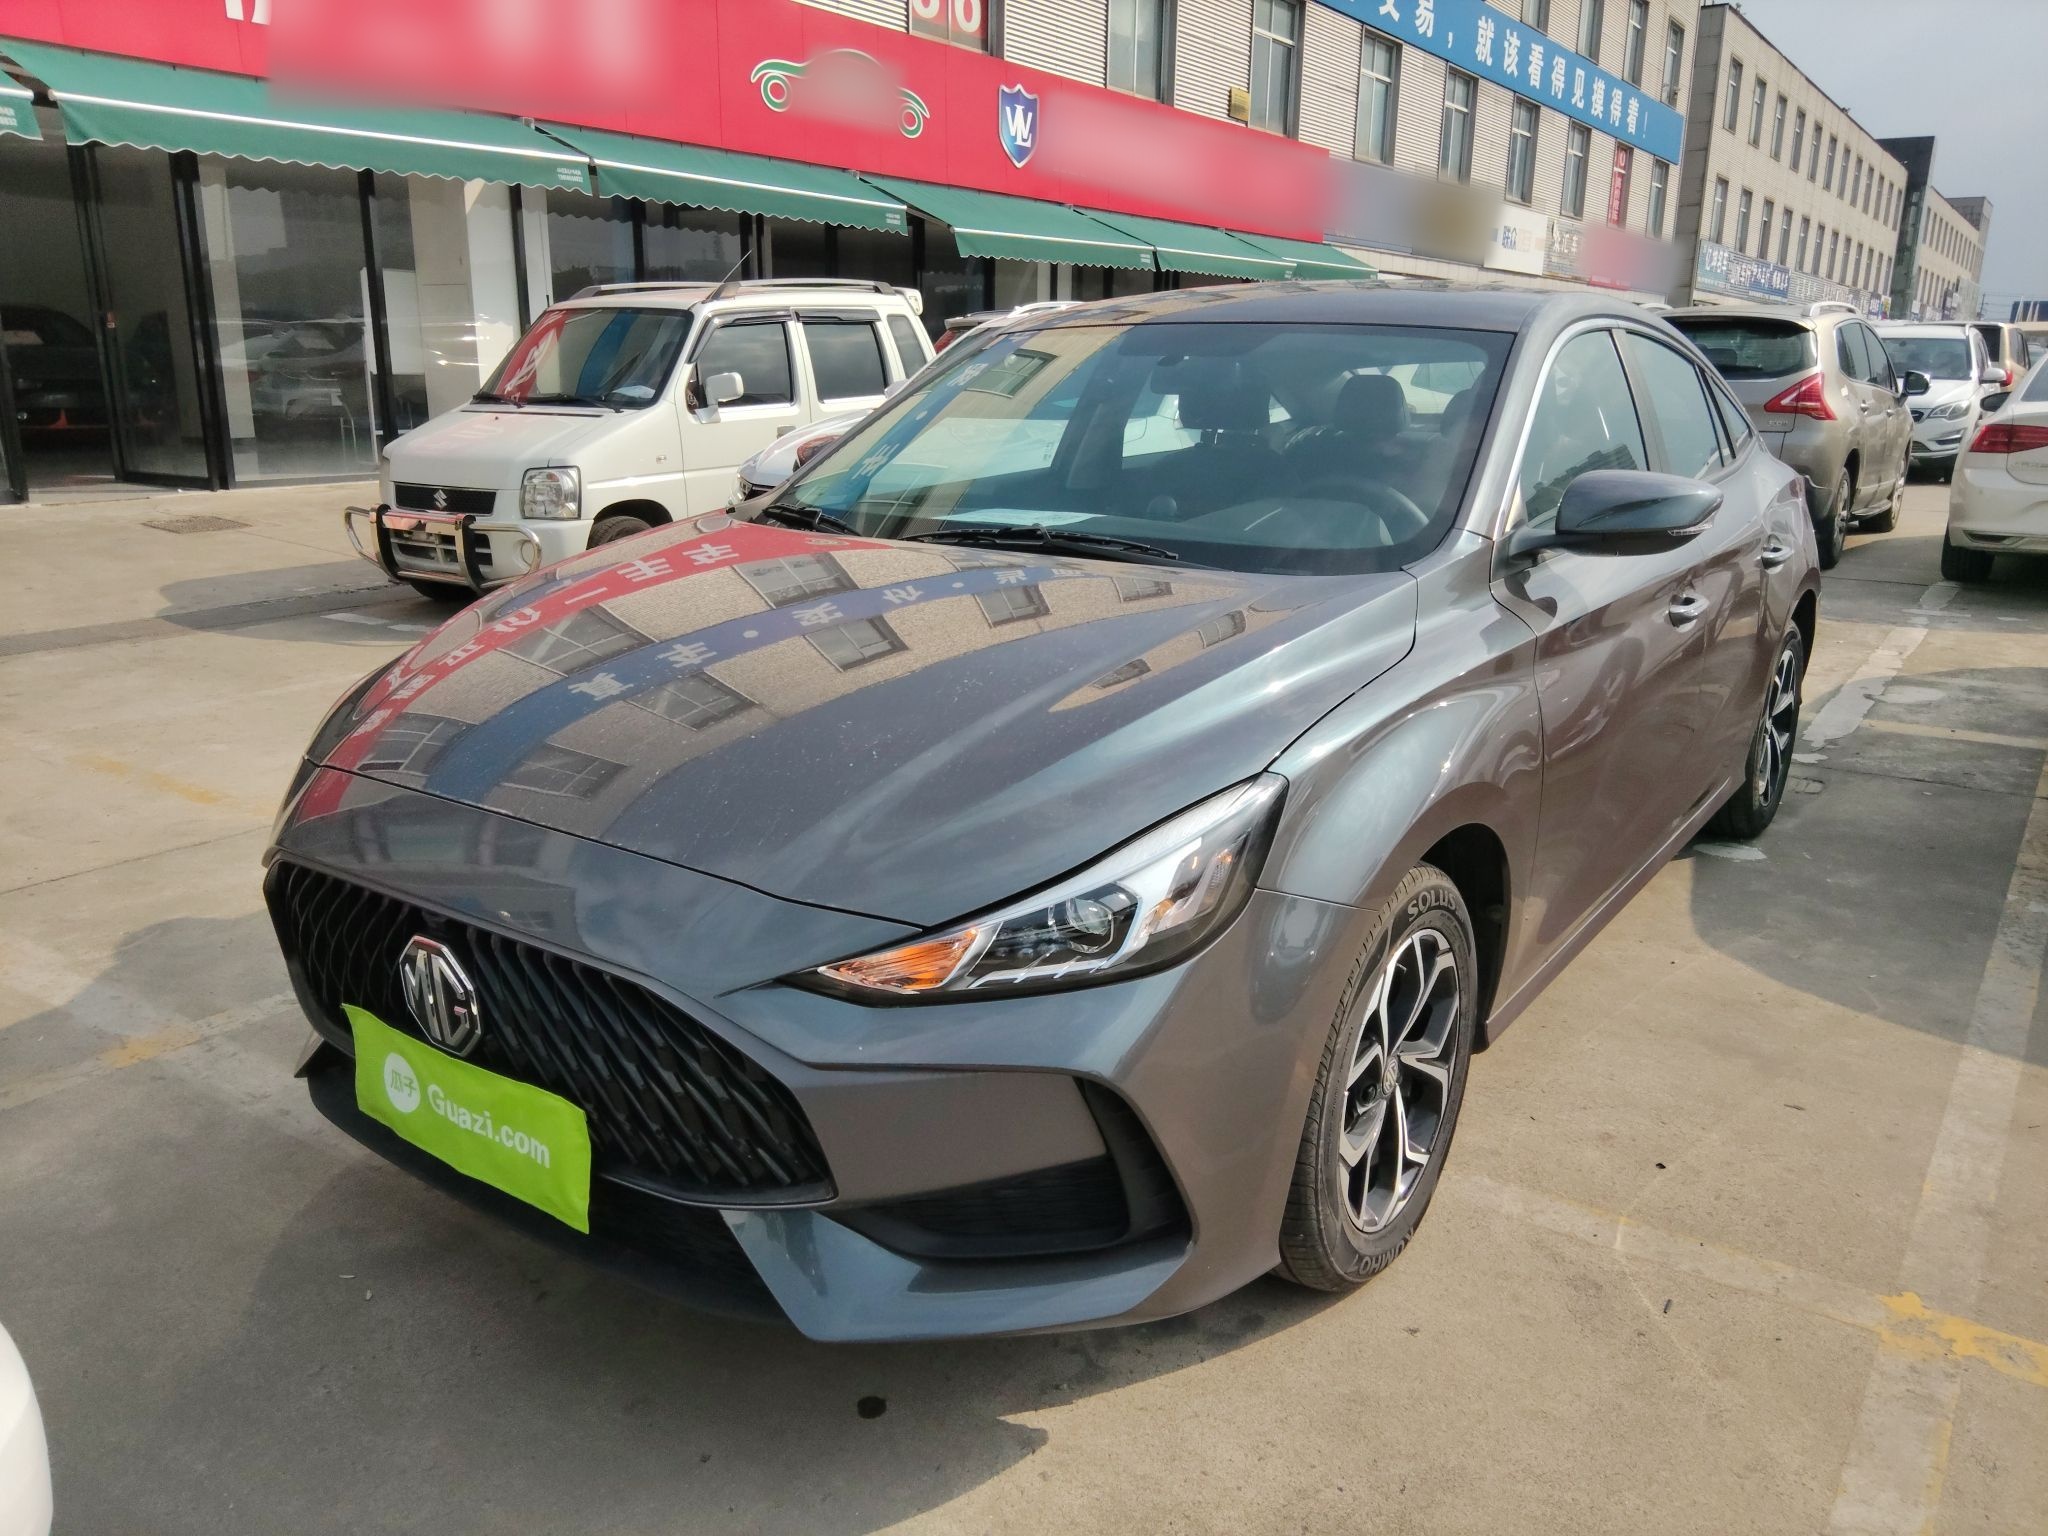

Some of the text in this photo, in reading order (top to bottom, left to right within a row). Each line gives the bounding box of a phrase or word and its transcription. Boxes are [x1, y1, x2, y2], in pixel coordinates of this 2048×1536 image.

[1407, 889, 1456, 921] SOLUS
[404, 949, 470, 1047] MG
[391, 1068, 417, 1098] 瓜子
[427, 1083, 550, 1168] Guazi.com
